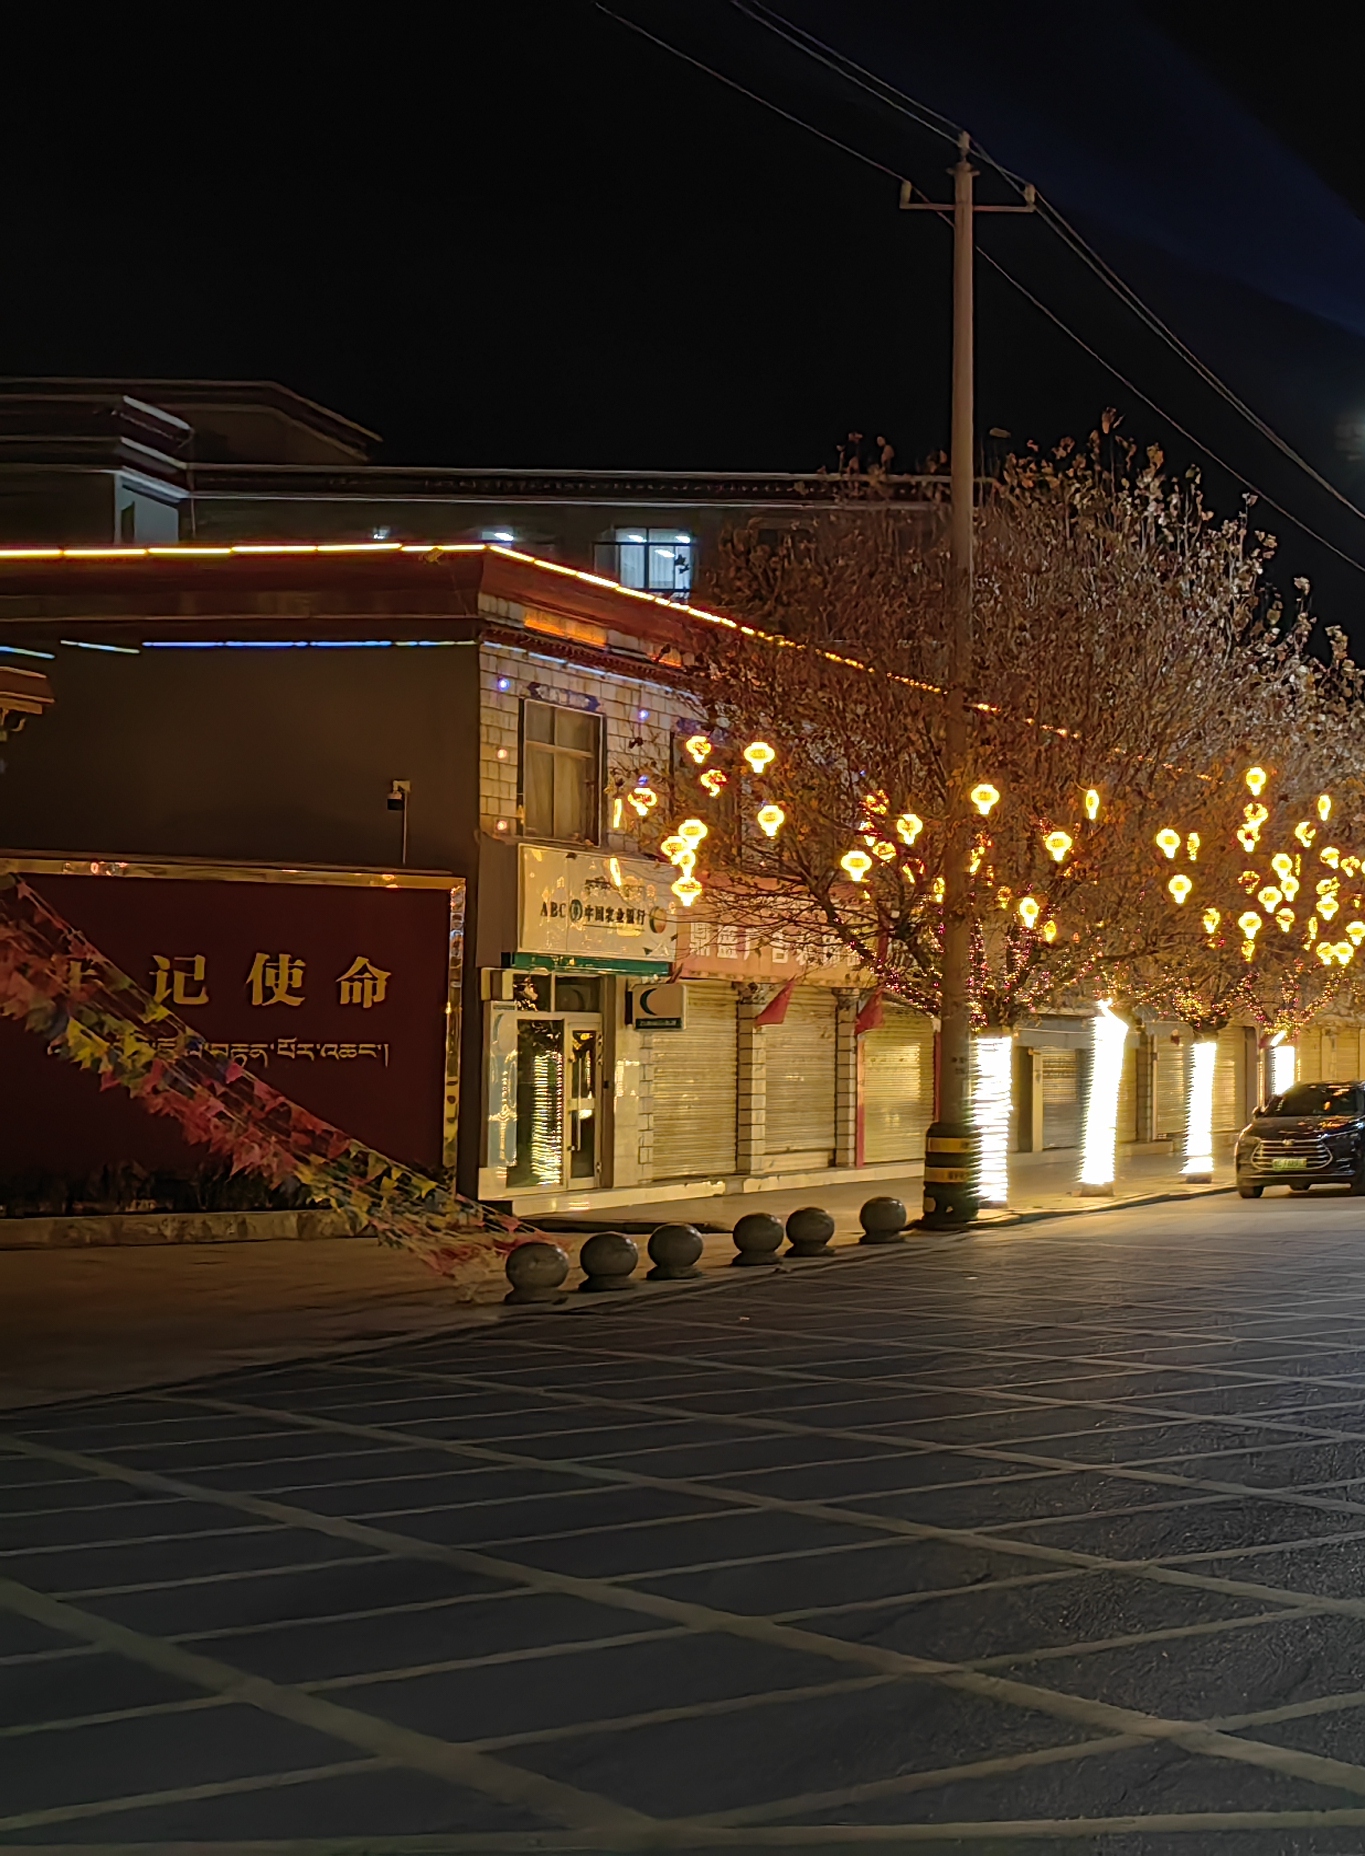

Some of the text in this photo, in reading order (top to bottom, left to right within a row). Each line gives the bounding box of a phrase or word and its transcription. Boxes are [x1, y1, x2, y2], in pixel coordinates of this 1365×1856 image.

[540, 901, 567, 919] ABC
[584, 904, 646, 926] 中国农业银行
